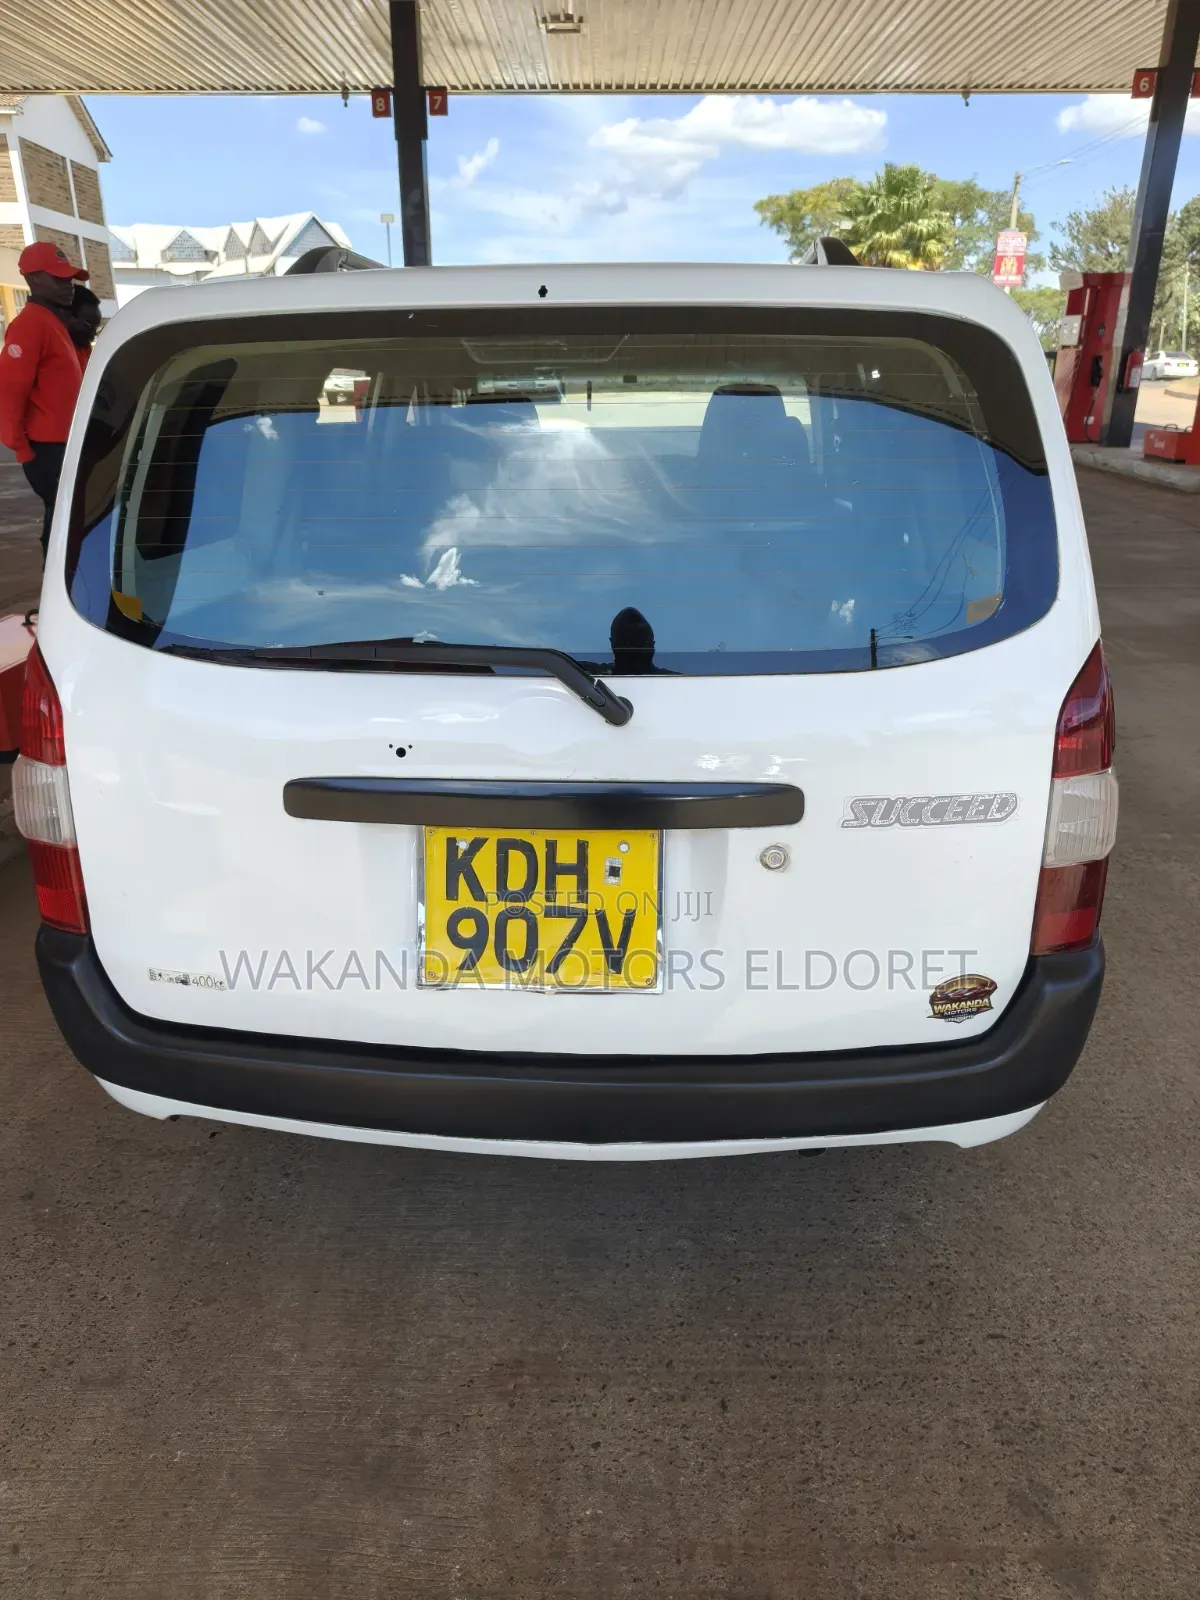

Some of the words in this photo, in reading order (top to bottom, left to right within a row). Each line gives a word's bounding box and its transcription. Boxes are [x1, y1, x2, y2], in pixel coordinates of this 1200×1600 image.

[1139, 77, 1150, 92] 6
[375, 97, 386, 112] 8
[433, 95, 442, 110] 7
[841, 792, 1018, 829] SUCCEED
[445, 836, 589, 905] KDH
[446, 904, 637, 975] 907V
[933, 998, 989, 1013] WAKANDA
[943, 1007, 977, 1016] MOTORS
